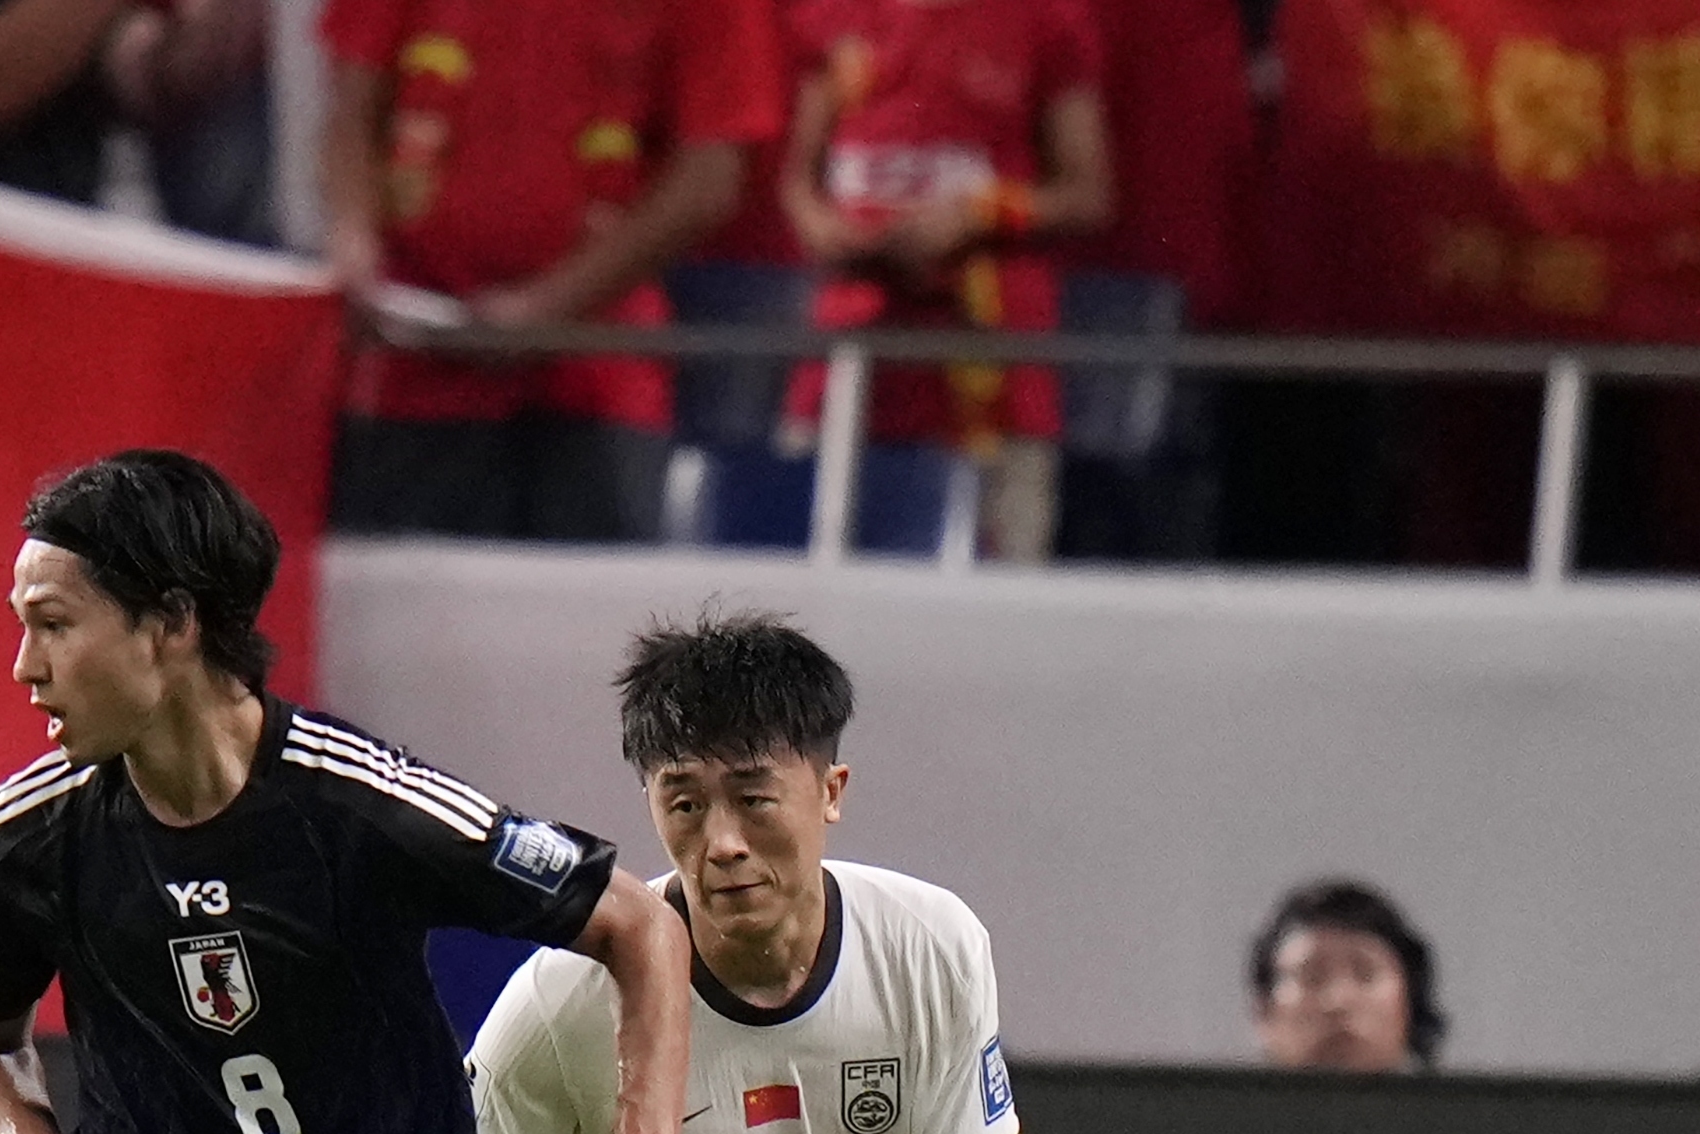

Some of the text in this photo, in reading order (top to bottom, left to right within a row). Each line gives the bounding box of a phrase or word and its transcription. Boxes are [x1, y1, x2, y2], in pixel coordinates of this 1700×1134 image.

[165, 880, 231, 918] Y-3
[189, 938, 226, 951] JAPAN
[847, 1063, 895, 1080] CFA
